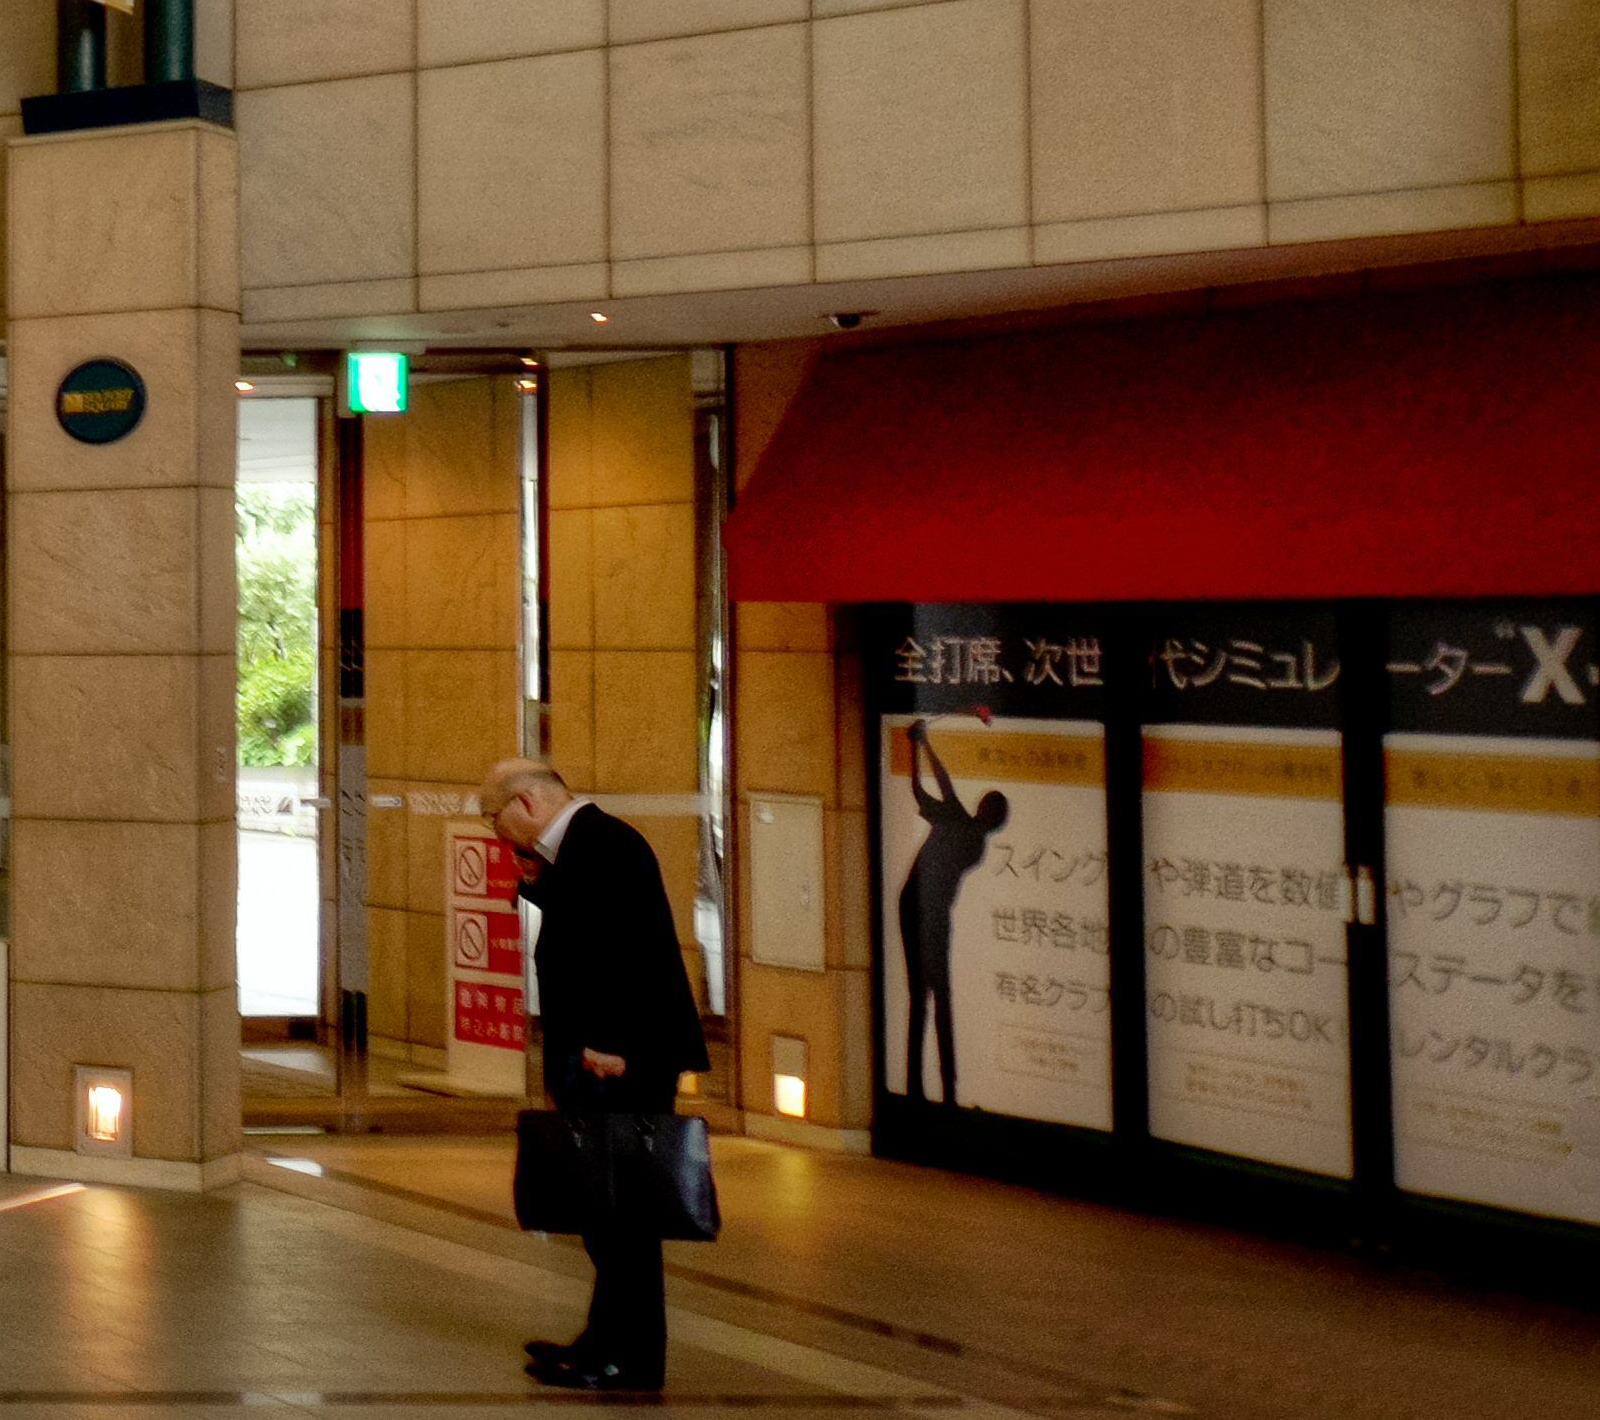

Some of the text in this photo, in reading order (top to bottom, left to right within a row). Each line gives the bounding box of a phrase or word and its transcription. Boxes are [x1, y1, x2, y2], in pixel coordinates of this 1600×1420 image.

[894, 635, 1104, 687] 全打席、次世
